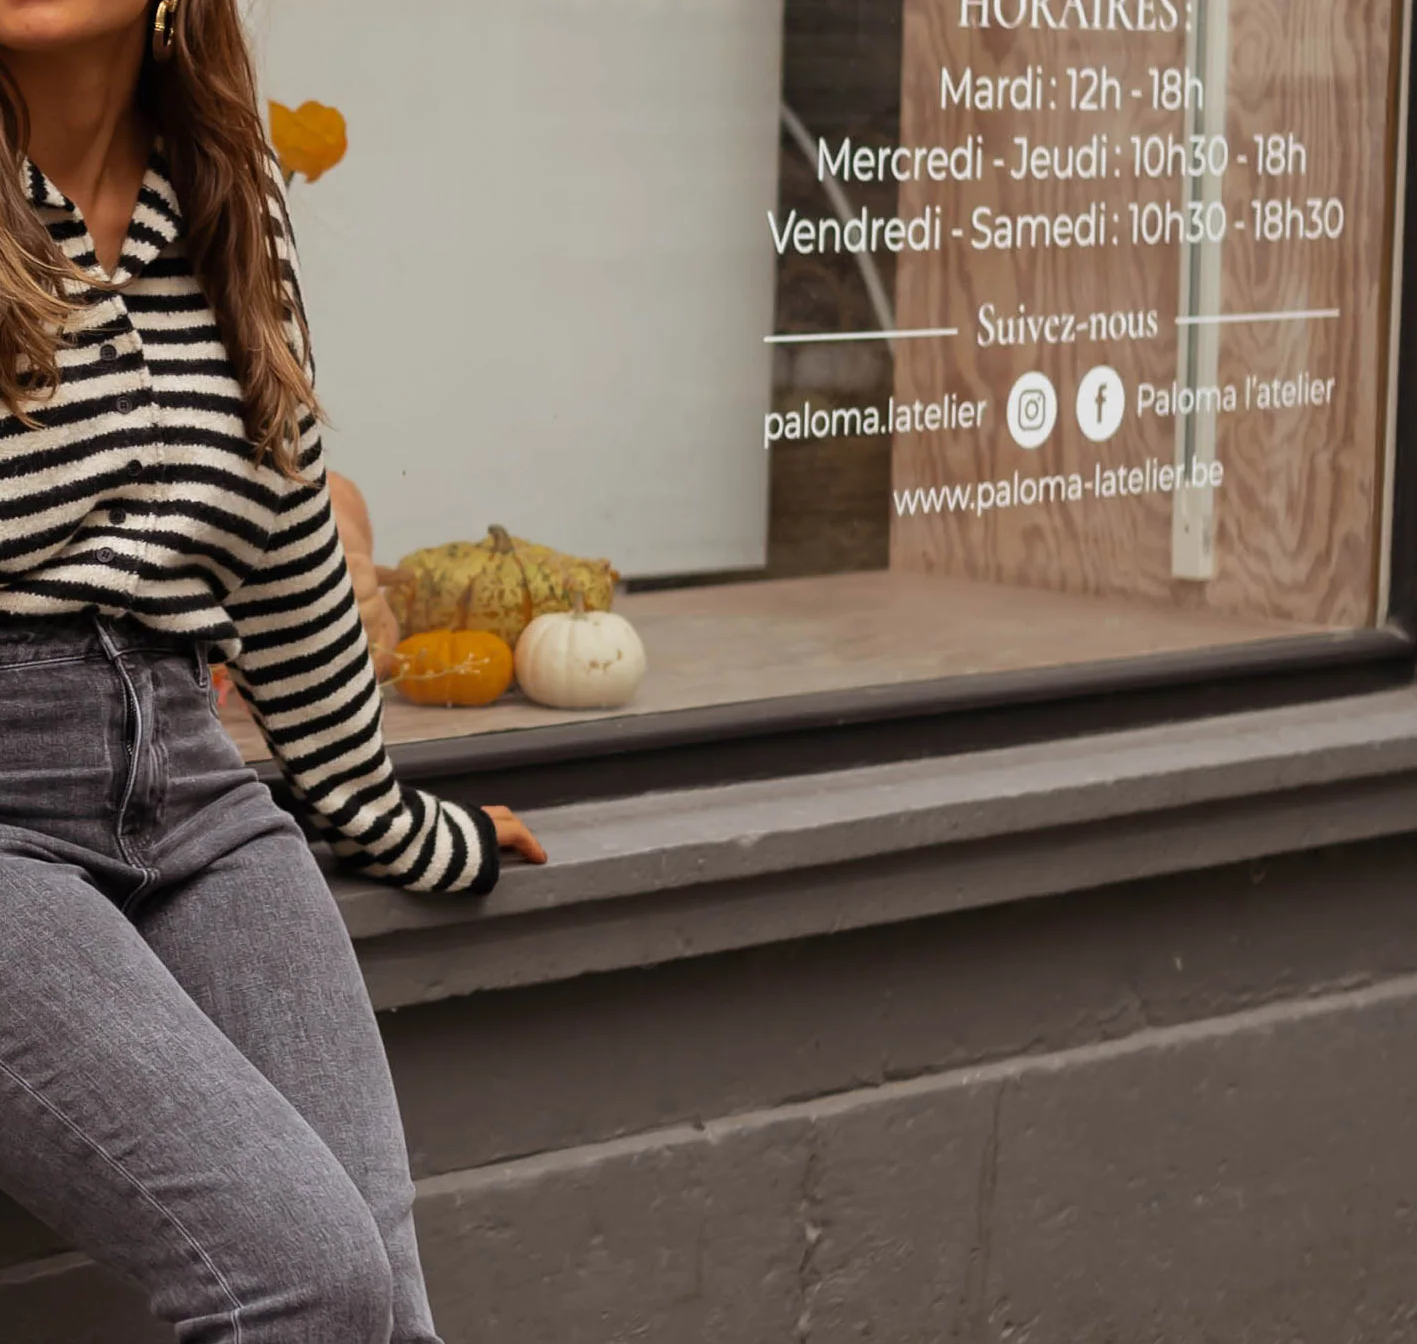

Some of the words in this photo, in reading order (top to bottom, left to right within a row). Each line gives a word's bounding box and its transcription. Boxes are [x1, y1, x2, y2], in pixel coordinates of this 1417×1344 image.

[1065, 65, 1121, 111] 12h
[1148, 65, 1205, 111] 18h
[817, 133, 984, 182] Mercredi
[1130, 132, 1229, 178] 10h30
[1253, 132, 1307, 176] 18h
[767, 205, 942, 255] Vendredi
[1128, 199, 1227, 245] 10h30
[1251, 196, 1345, 242] 18h30
[976, 302, 1159, 348] Suivez-nous
[1136, 380, 1238, 419] Paloma
[1244, 369, 1336, 411] l'atelier
[763, 393, 988, 450] paloma.latelier
[893, 451, 1224, 518] www.paloma-latelier.be
